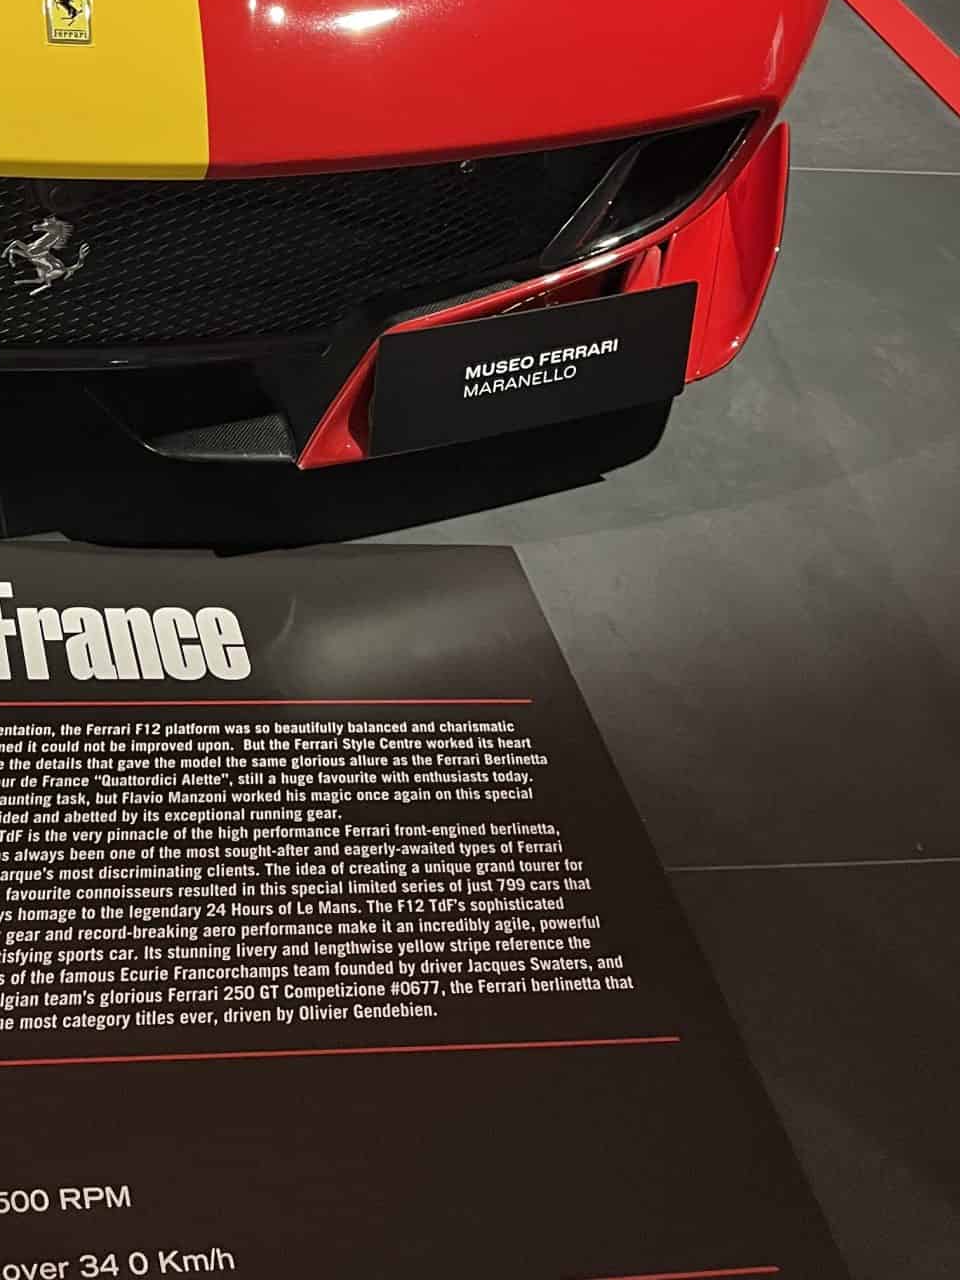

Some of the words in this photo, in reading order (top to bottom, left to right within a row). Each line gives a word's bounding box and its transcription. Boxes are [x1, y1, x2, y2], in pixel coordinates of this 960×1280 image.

[465, 355, 534, 380] MUSEO
[539, 338, 618, 367] FERRARI
[463, 365, 577, 398] MARANELLO
[60, 723, 82, 736] the
[86, 722, 131, 736] Ferrari
[135, 722, 161, 736] F12
[165, 722, 221, 738] platform
[224, 724, 251, 735] was
[254, 724, 271, 734] so
[274, 721, 344, 736] beautifully
[347, 720, 408, 734] balanced
[411, 720, 436, 733] and
[439, 720, 515, 733] charismatic
[32, 810, 60, 824] and
[63, 809, 117, 824] abetted
[121, 809, 139, 825] by
[143, 808, 160, 823] its
[164, 807, 245, 825] exceptional
[250, 806, 303, 823] running
[306, 809, 342, 823] gear.
[5, 930, 41, 946] gear
[44, 926, 73, 942] and
[77, 923, 199, 942] record-breaking
[202, 925, 236, 938] aero
[241, 921, 333, 940] performance
[337, 919, 377, 934] make
[381, 918, 393, 934] it
[396, 921, 414, 933] an
[418, 917, 491, 935] incredibly
[494, 916, 536, 934] agile,
[539, 915, 601, 934] powerful
[19, 1014, 58, 1030] most
[62, 1013, 131, 1031] category
[135, 1009, 175, 1026] titles
[180, 1011, 218, 1026] ever,
[223, 1006, 272, 1023] driven
[276, 1006, 294, 1025] by
[298, 1004, 349, 1021] Olivier
[353, 1001, 438, 1019] Gendebien.
[60, 1186, 130, 1210] RPM
[3, 1262, 69, 1280] over
[159, 1248, 235, 1273] Km/h
